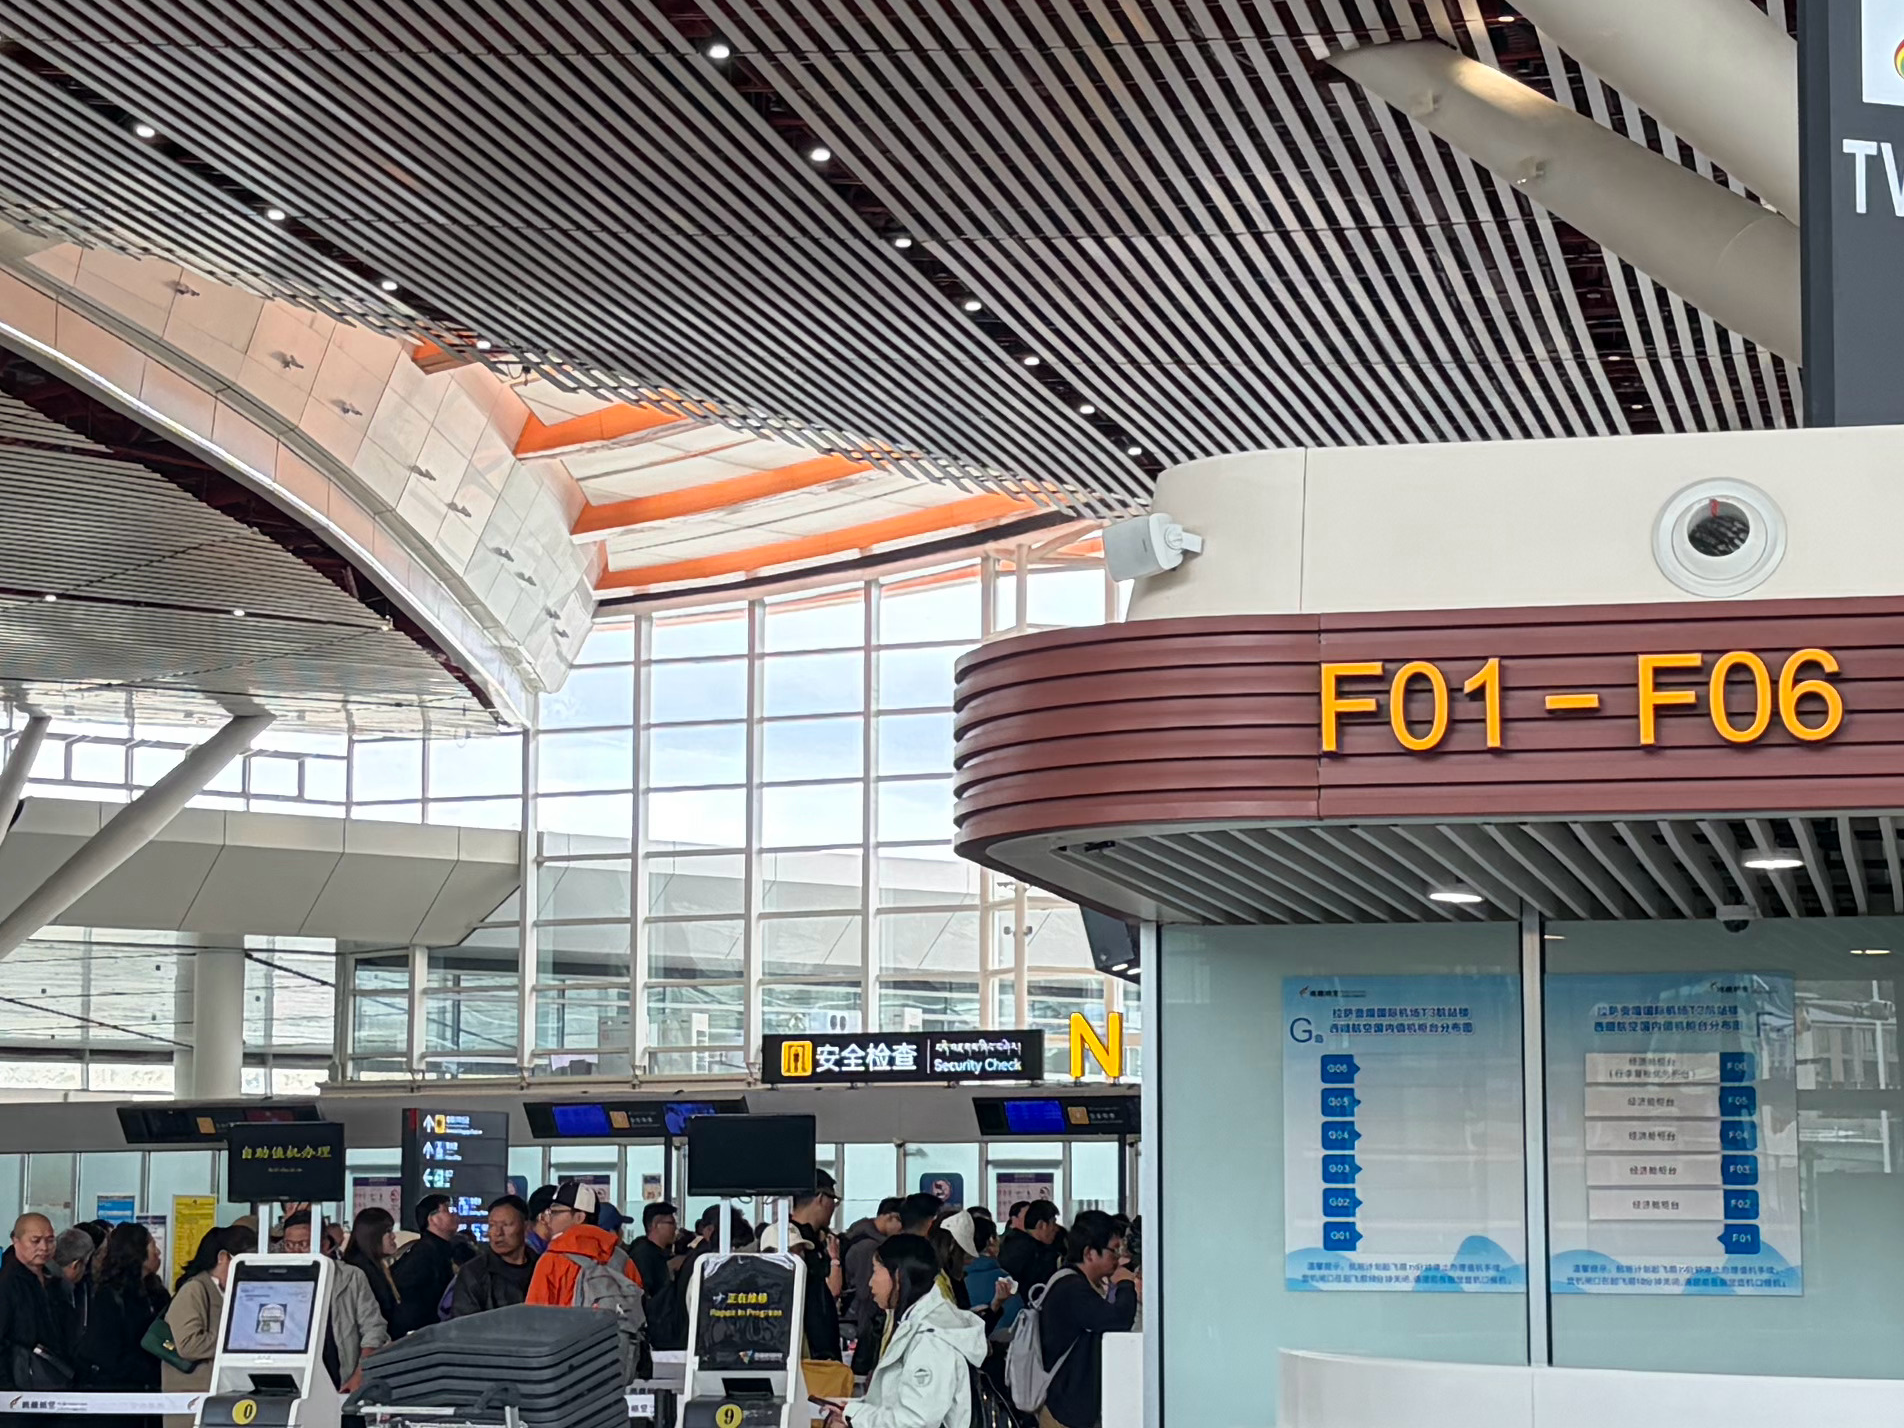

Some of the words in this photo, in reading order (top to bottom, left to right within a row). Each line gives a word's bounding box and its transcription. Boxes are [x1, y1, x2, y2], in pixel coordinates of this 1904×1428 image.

[1319, 657, 1504, 754] F01
[1637, 647, 1844, 748] F06
[1290, 1018, 1313, 1043] G
[1069, 1012, 1123, 1078] N
[816, 1043, 918, 1072] 安全检查
[934, 1058, 982, 1075] Security
[985, 1057, 1022, 1071] Check
[241, 1145, 332, 1159] 自助值机办理
[1732, 1235, 1752, 1243] F01
[244, 1403, 253, 1420] 0
[724, 1408, 734, 1424] 9
